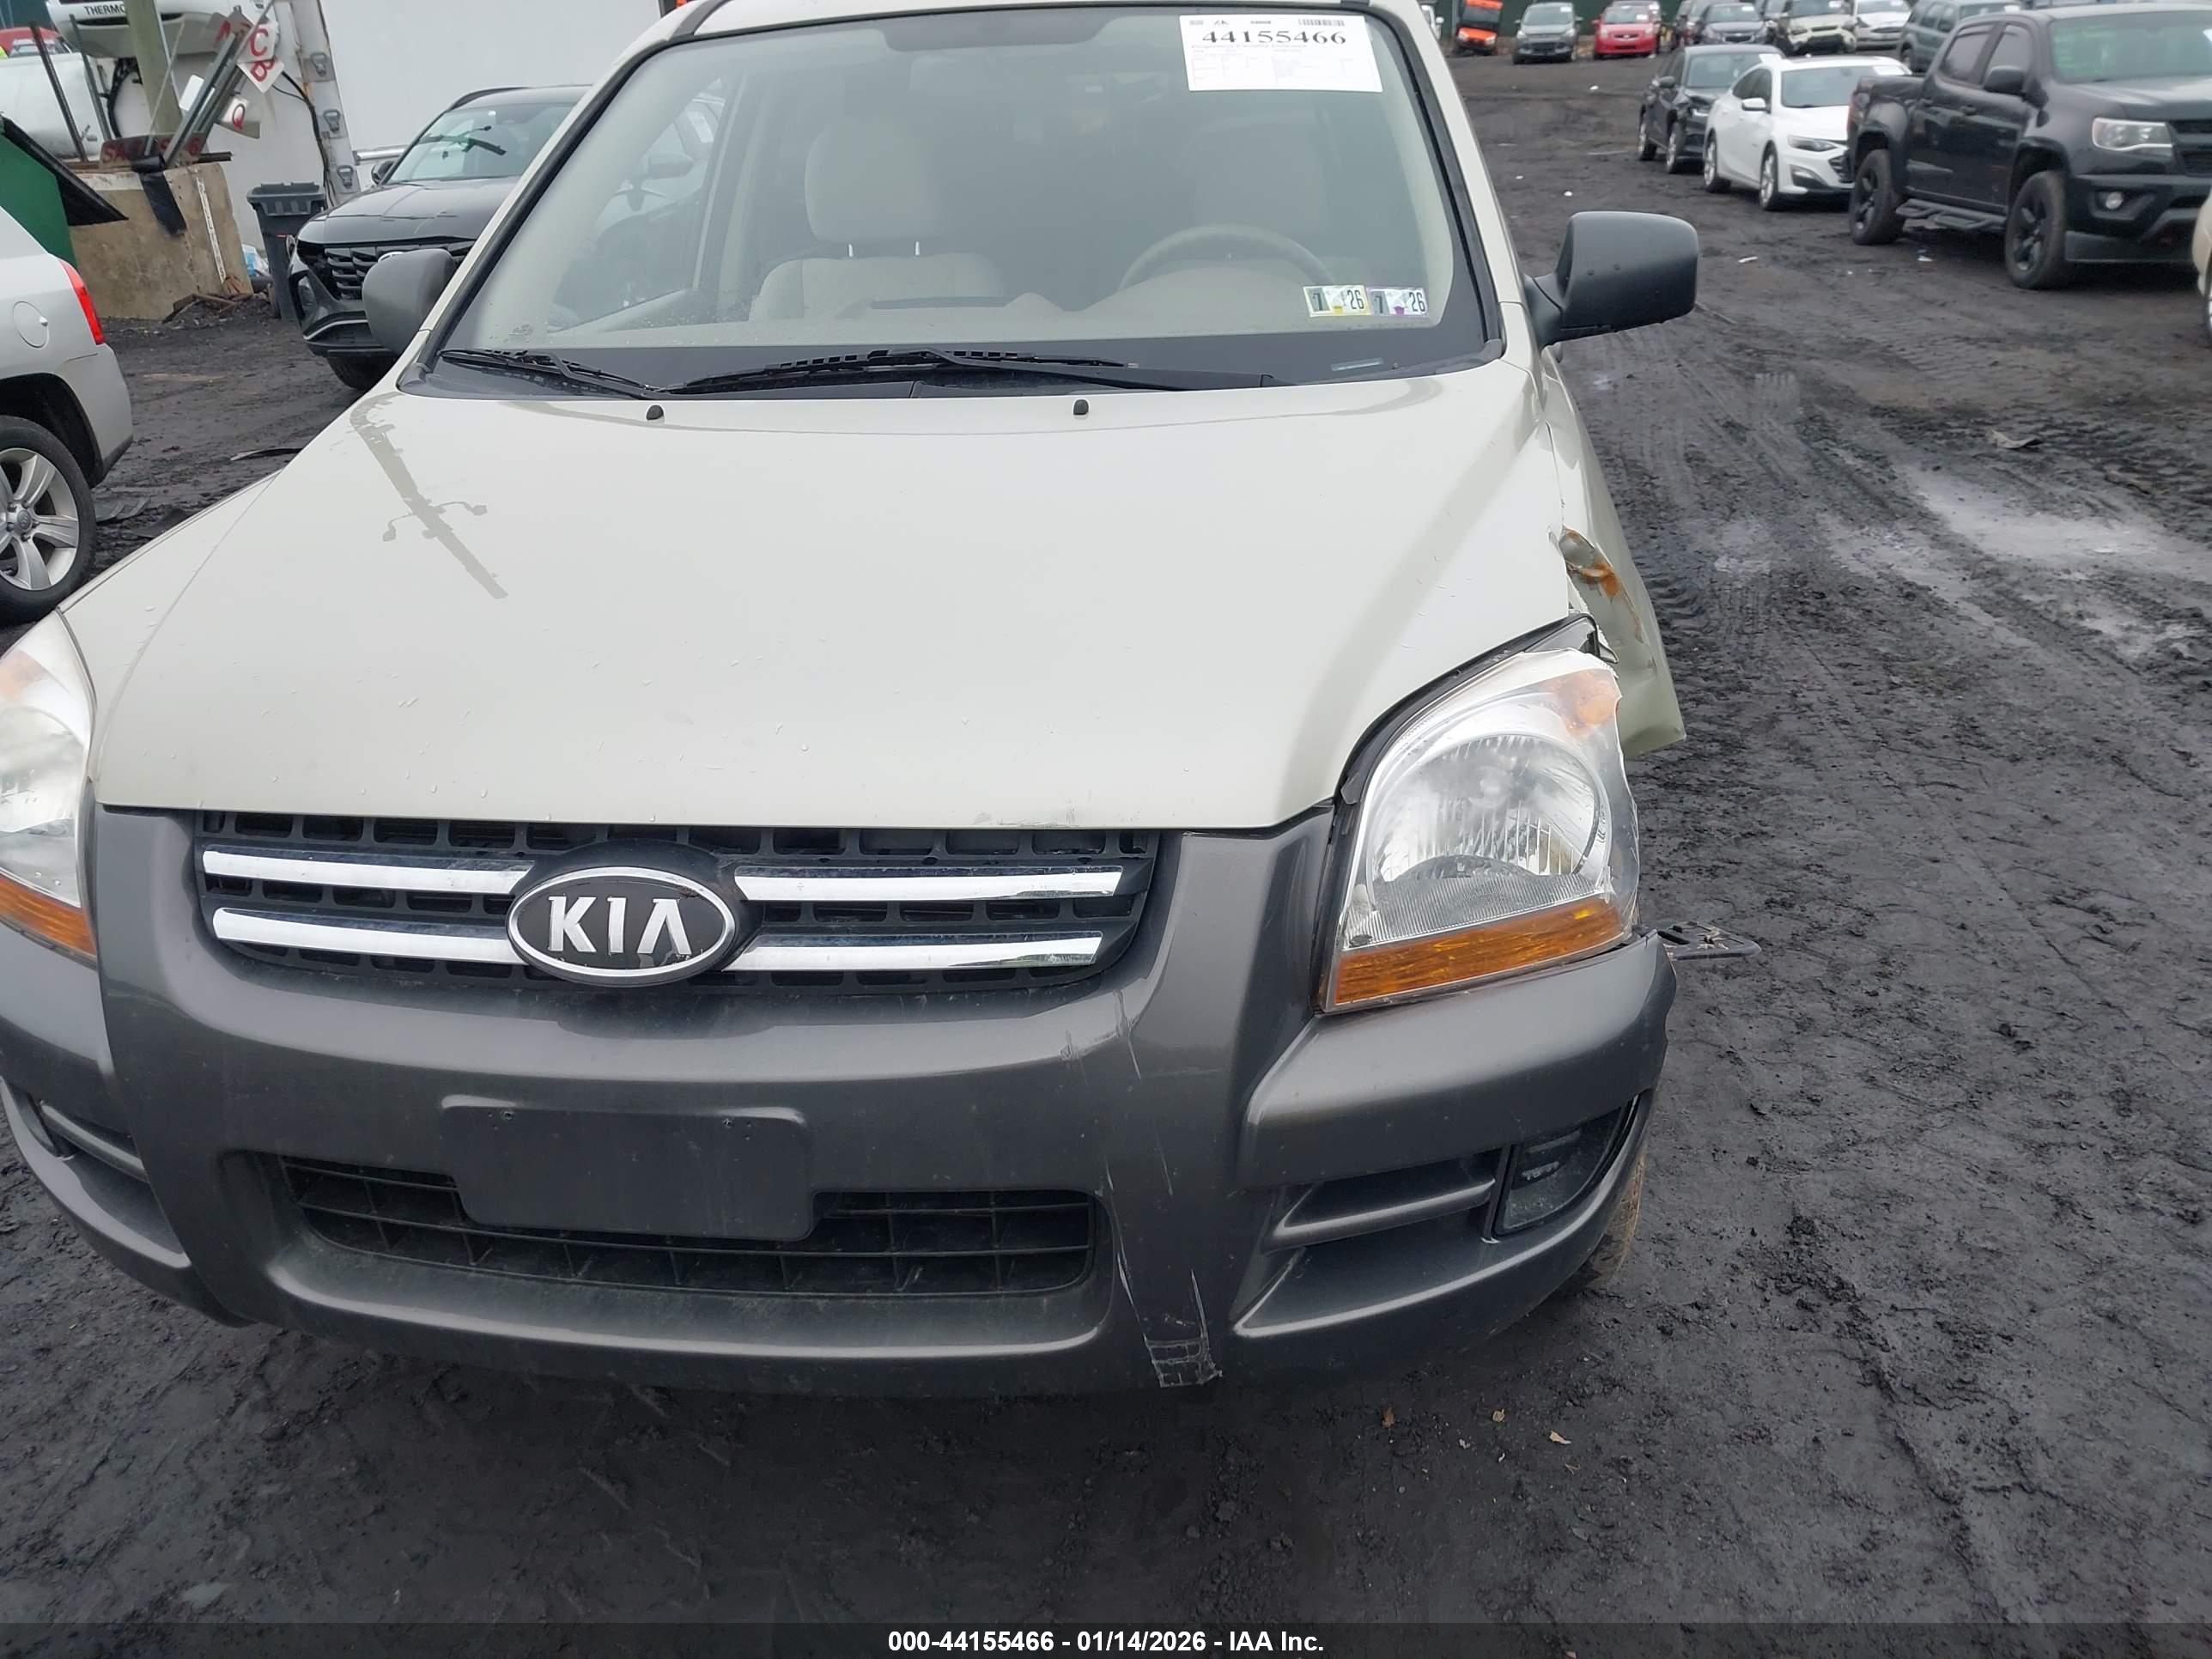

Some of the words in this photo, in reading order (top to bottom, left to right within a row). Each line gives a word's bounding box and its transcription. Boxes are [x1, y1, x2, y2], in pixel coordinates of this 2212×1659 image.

[250, 27, 269, 57] C
[1202, 30, 1346, 44] 44155466
[1346, 289, 1364, 310] 26
[1408, 291, 1426, 313] 26
[547, 896, 692, 955] KIA
